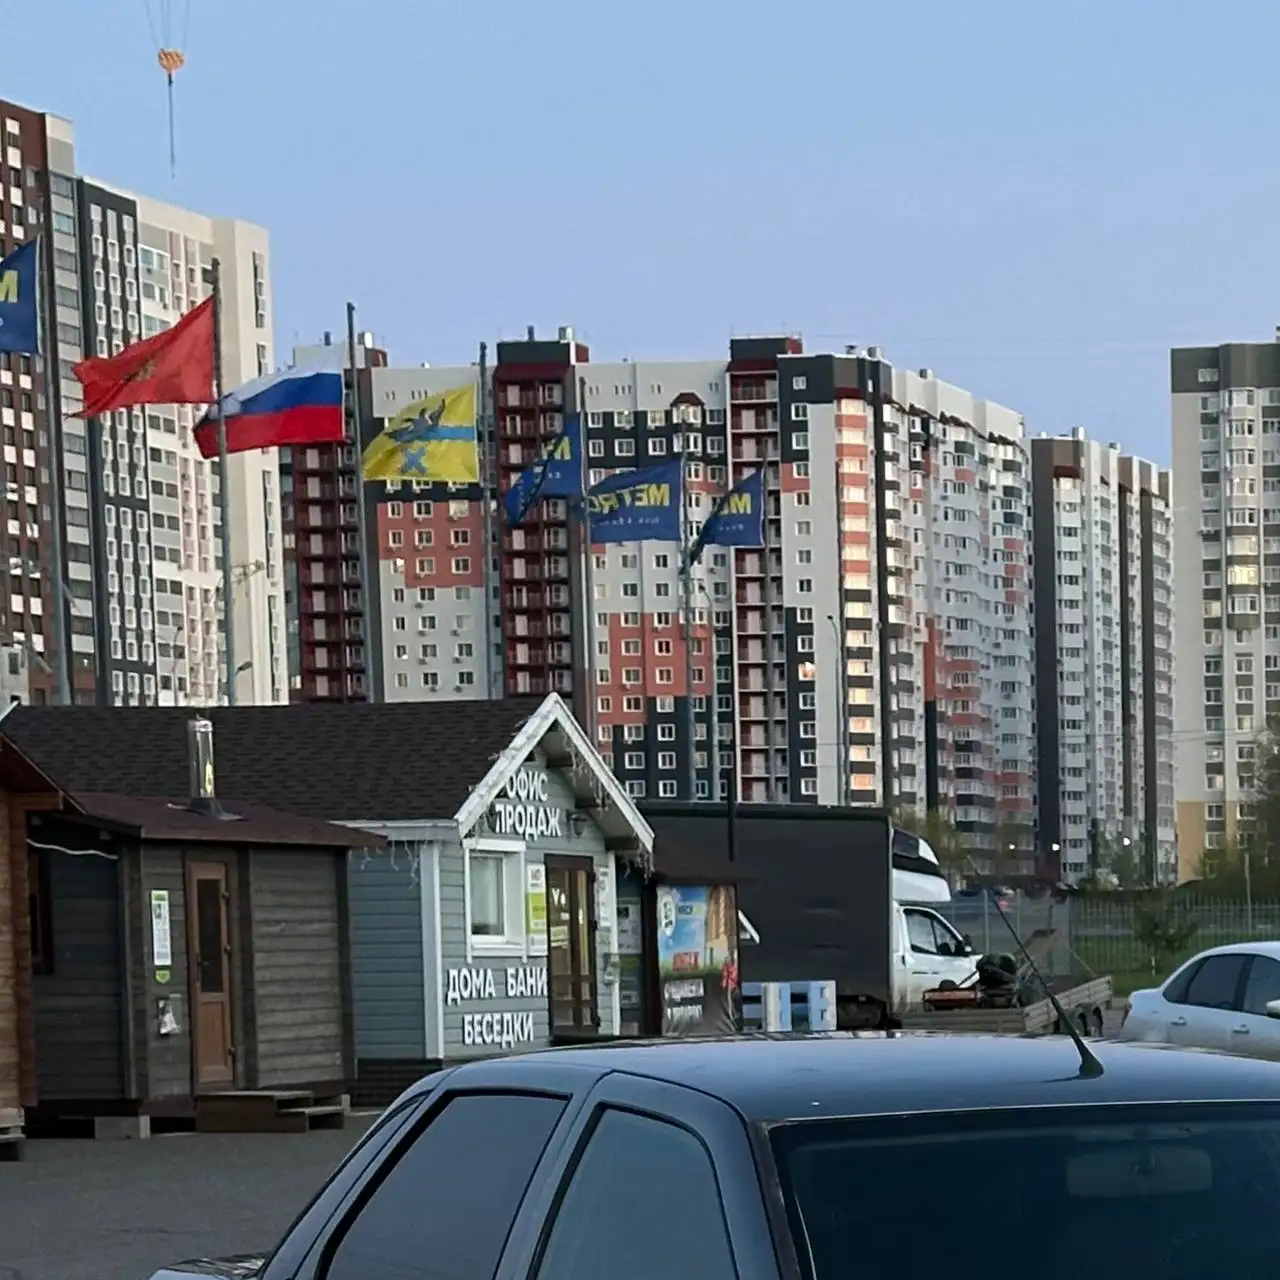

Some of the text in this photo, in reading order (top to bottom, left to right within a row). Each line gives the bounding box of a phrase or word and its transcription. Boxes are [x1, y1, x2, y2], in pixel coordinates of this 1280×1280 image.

[505, 767, 549, 802] ОФИС
[494, 803, 562, 841] ПРОДАЖ
[446, 966, 548, 1006] ДОМА БАНИ
[463, 1012, 535, 1049] БЕСЕДКИ
